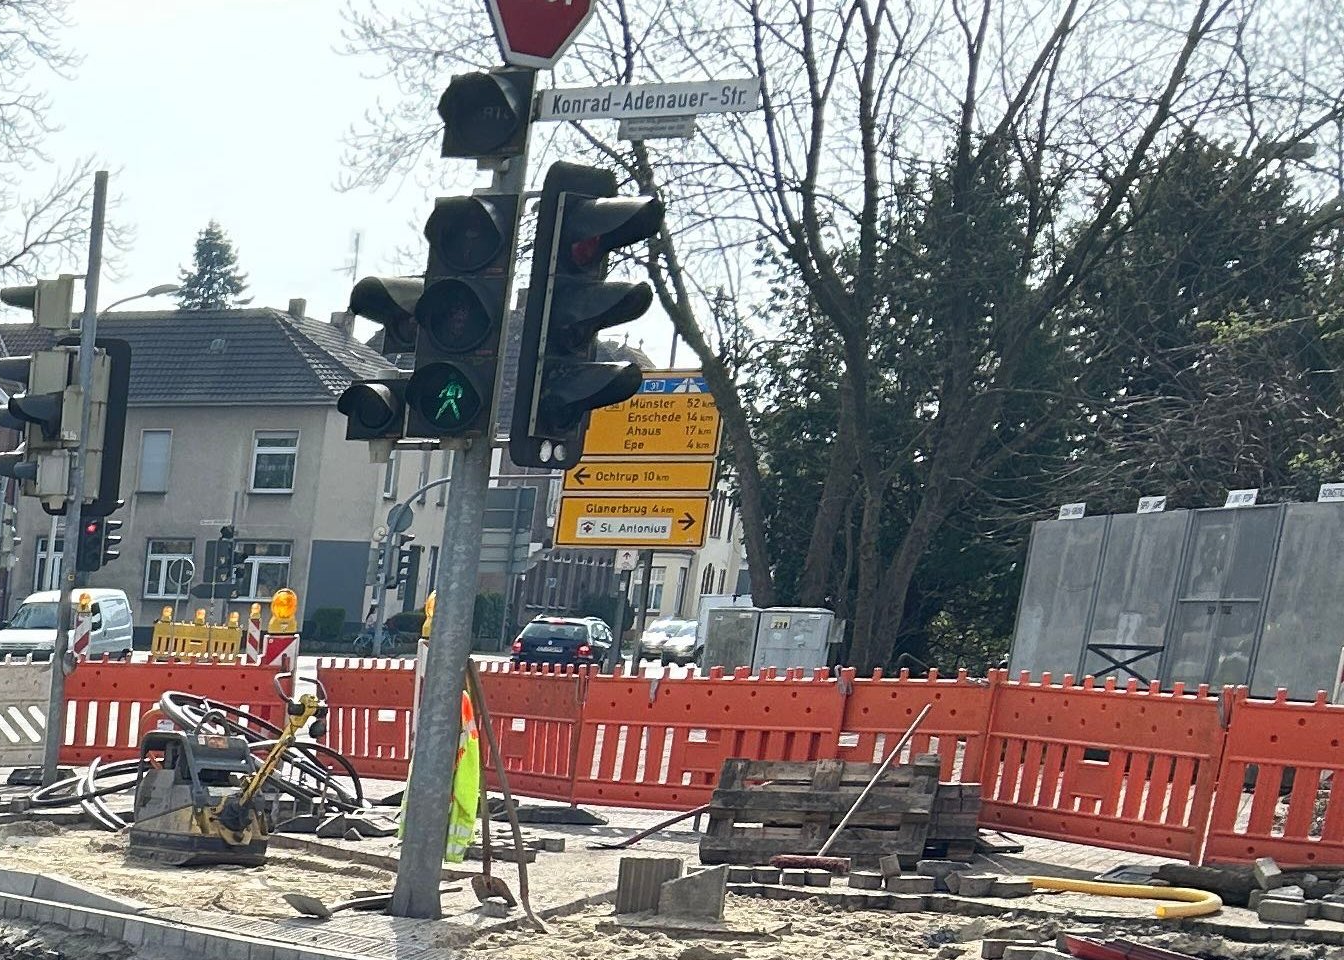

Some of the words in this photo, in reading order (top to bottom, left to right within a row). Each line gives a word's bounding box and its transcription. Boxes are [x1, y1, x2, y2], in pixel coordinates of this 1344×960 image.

[551, 85, 747, 115] Konrad-Adenauer-Str.
[629, 398, 676, 409] Münster
[686, 398, 700, 408] 52
[627, 412, 682, 423] Enschede
[686, 411, 698, 422] 14
[699, 413, 714, 421] km
[625, 426, 662, 436] Ahaus
[685, 425, 697, 435] 17
[697, 427, 712, 435] km
[623, 439, 645, 452] Epe
[686, 439, 694, 449] 4
[695, 440, 711, 450] km
[595, 470, 639, 482] Ochtrup
[643, 470, 655, 481] 10
[585, 503, 647, 516] Glanerbrug
[651, 504, 659, 513] 4
[617, 523, 668, 534] Antonius
